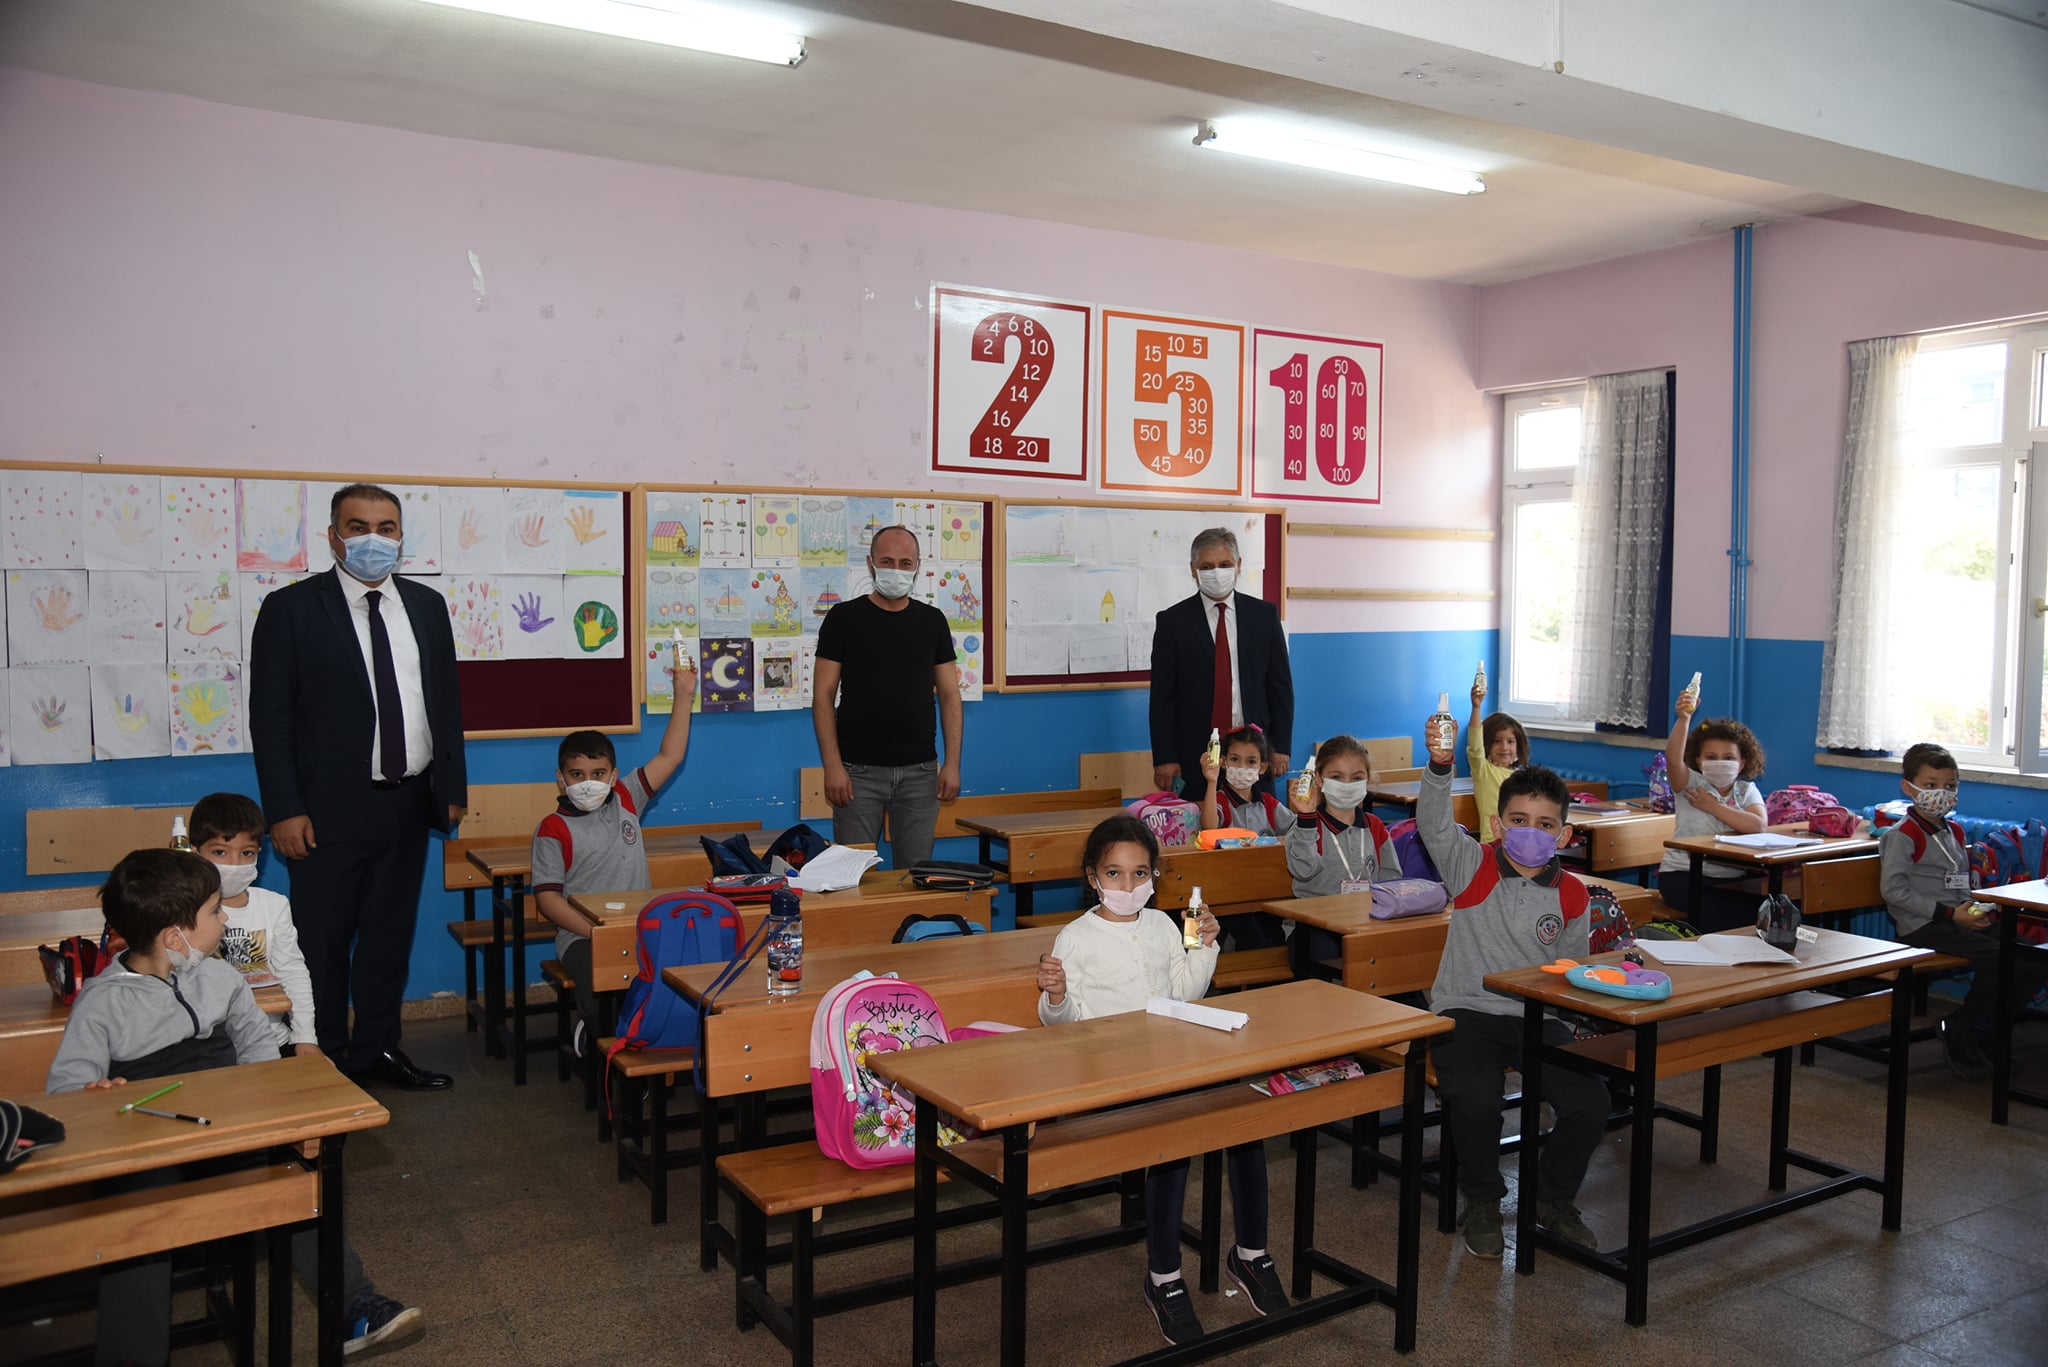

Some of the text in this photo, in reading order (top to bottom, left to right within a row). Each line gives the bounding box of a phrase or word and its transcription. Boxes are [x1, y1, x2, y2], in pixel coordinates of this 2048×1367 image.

[989, 316, 1034, 337] 4 6 8
[983, 339, 1049, 356] 2 10
[1144, 336, 1202, 362] 15 10 5
[1022, 364, 1040, 381] 12
[1290, 363, 1302, 378] 10
[1334, 359, 1348, 375] 50
[970, 312, 1055, 463] 2
[1142, 373, 1195, 392] 20 25
[1350, 382, 1364, 397] 70
[1010, 385, 1029, 403] 14
[1289, 390, 1303, 405] 20
[1322, 384, 1336, 399] 60
[1133, 329, 1213, 478] 5
[1188, 398, 1207, 415] 30
[992, 410, 1011, 428] 16
[1188, 418, 1207, 435] 35
[1269, 353, 1368, 486] 10
[1140, 425, 1160, 441] 50
[1289, 425, 1302, 440] 30
[1320, 423, 1366, 441] 80 90
[984, 437, 1039, 457] 18 20
[1151, 456, 1171, 473] 45
[1184, 448, 1204, 464] 40
[1288, 460, 1302, 475] 40
[1332, 467, 1351, 482] 100
[1146, 812, 1168, 830] LOVE
[854, 991, 937, 1023] Besties!
